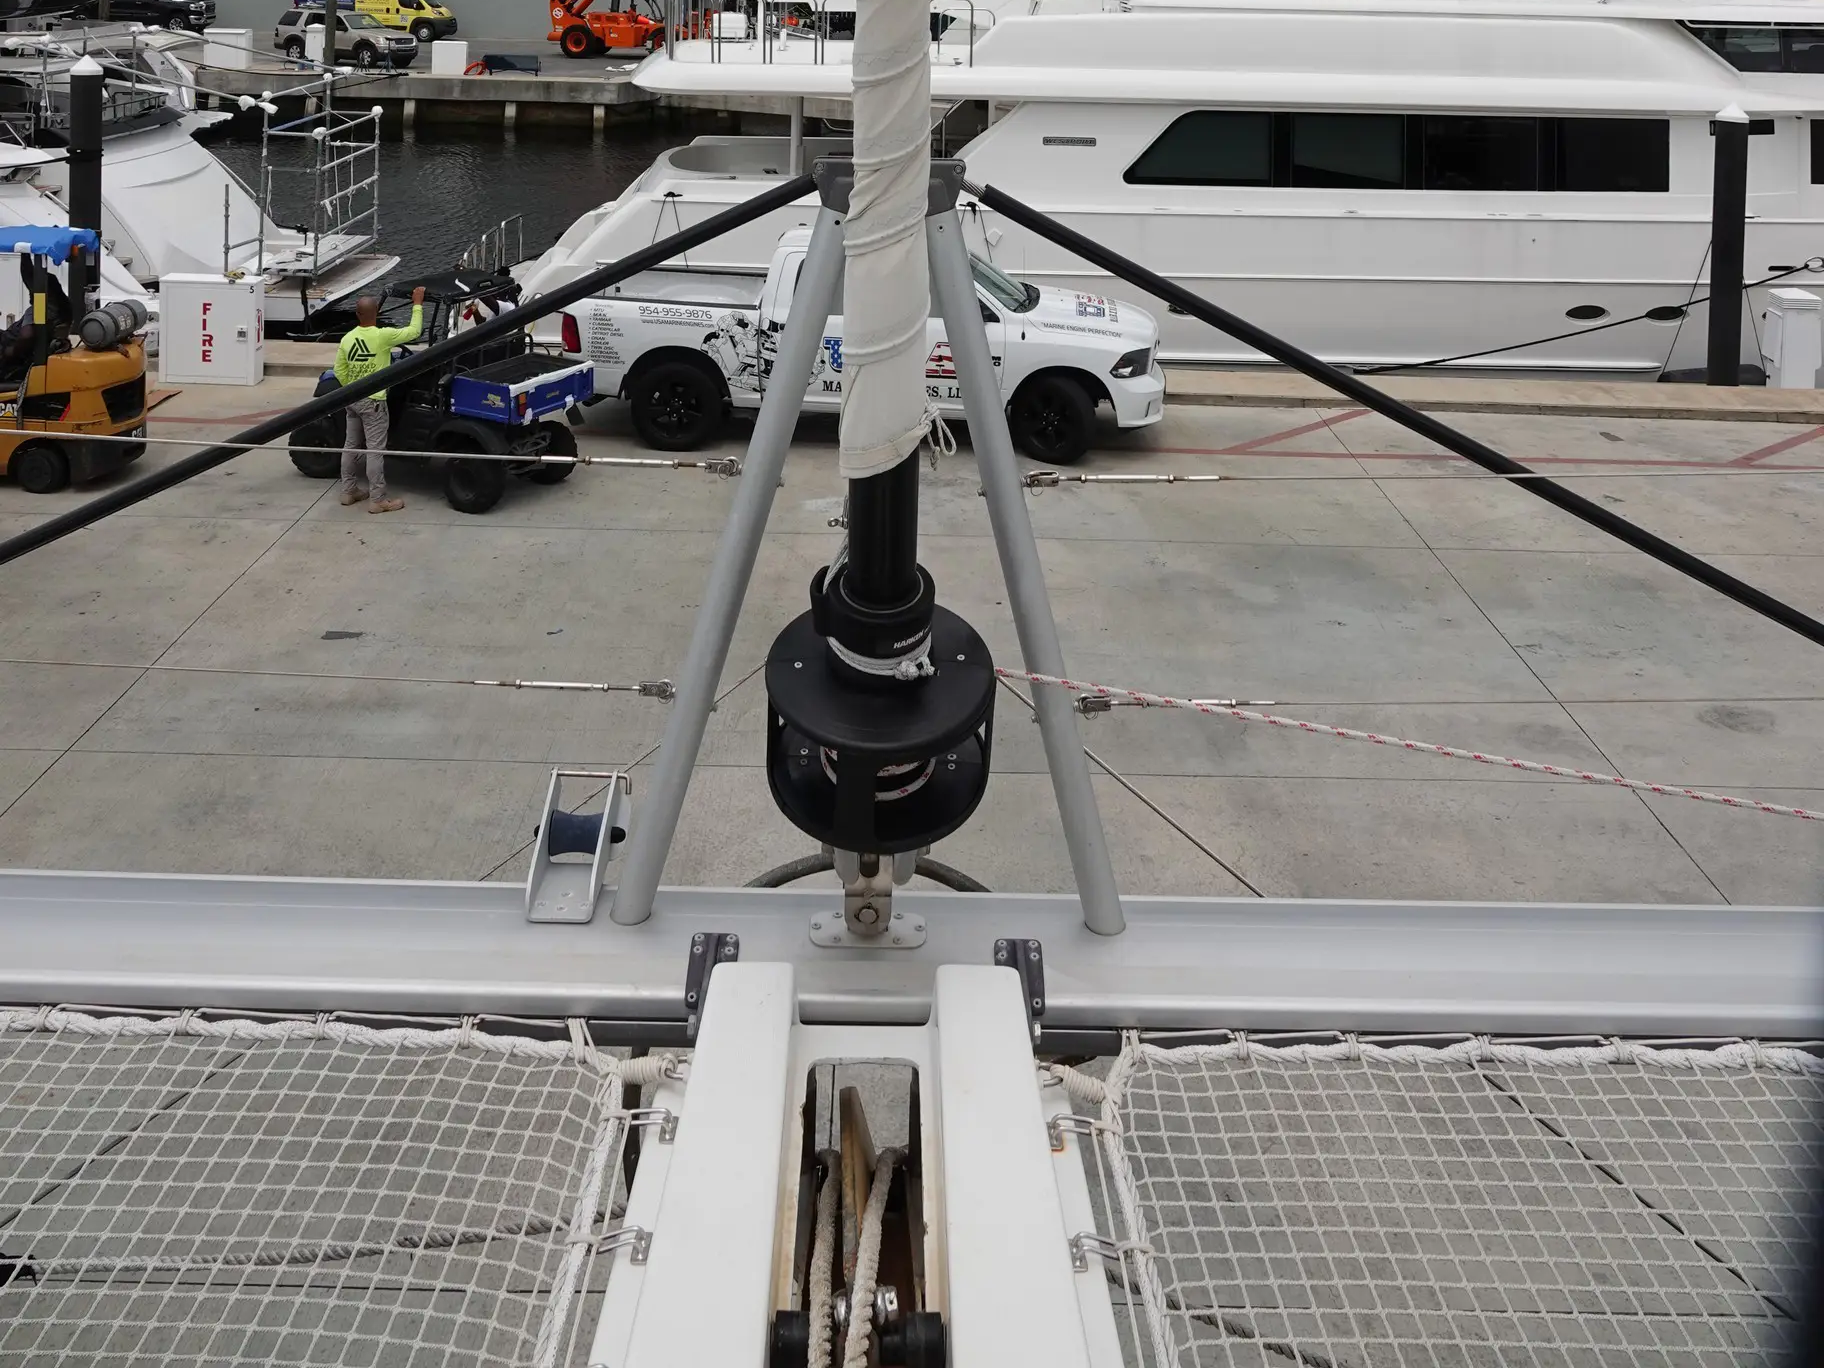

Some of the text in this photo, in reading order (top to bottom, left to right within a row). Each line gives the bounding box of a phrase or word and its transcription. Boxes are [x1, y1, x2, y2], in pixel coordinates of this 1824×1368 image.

[249, 285, 255, 293] 5
[638, 305, 713, 319] 954-955-9876
[202, 303, 214, 362] FIRE
[1066, 325, 1086, 333] ENGINE
[0, 403, 18, 416] CAT
